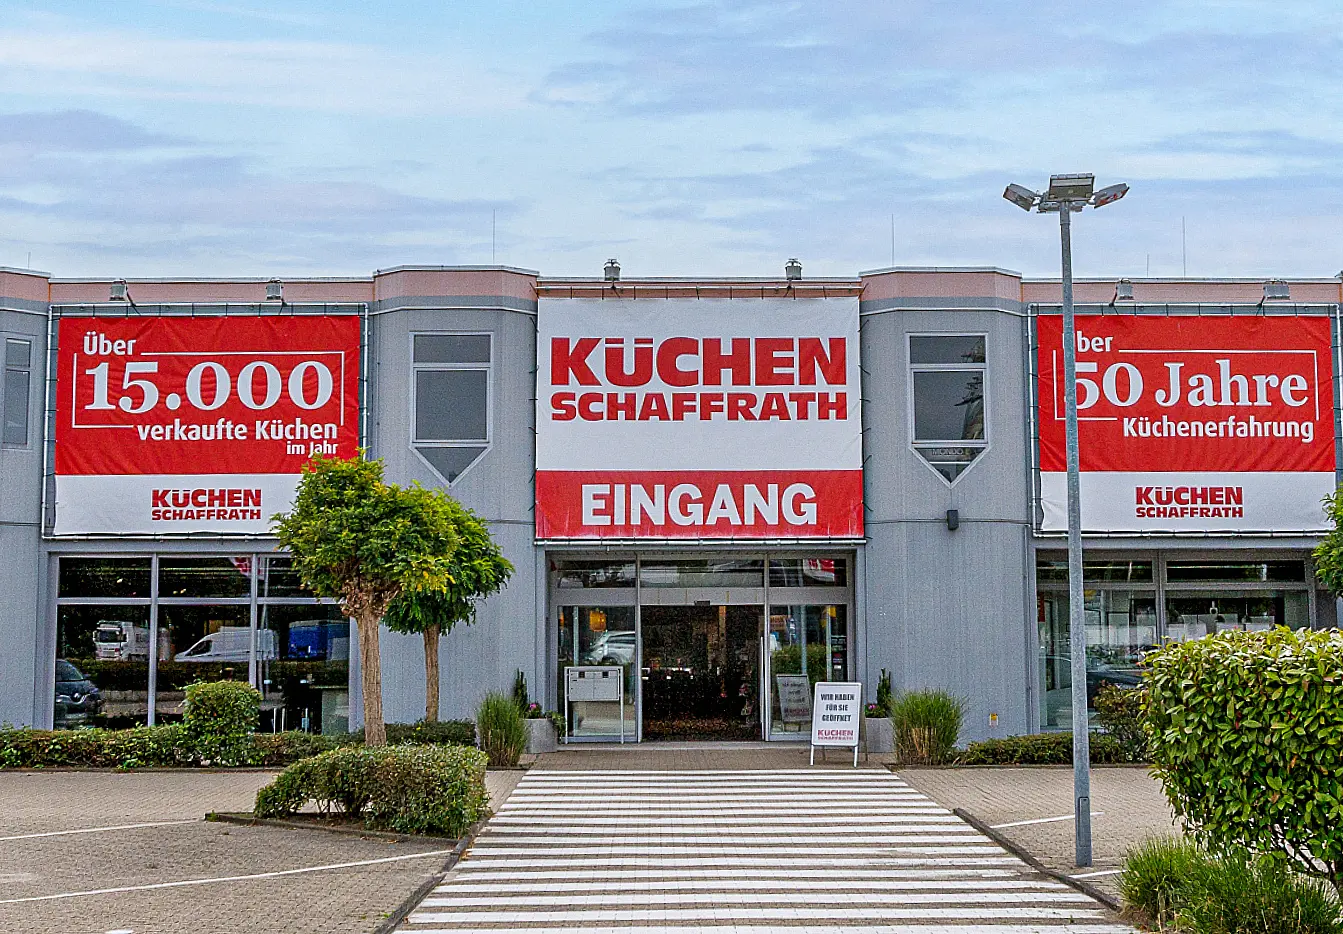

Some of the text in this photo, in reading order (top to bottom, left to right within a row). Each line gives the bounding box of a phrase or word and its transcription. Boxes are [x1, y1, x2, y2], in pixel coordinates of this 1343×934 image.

[82, 331, 137, 356] Über
[1062, 330, 1114, 353] ber
[550, 336, 847, 387] KÜCHEN
[84, 360, 334, 414] 15.000
[1064, 359, 1309, 410] 50 Jahre
[550, 391, 848, 421] SCHAFFRATH
[136, 417, 338, 441] verkaufte Küchen
[1123, 415, 1315, 443] Küchenerfahrung
[286, 440, 338, 458] im Jahr
[151, 488, 262, 508] KÜCHEN
[581, 483, 817, 526] EINGANG
[1135, 486, 1243, 506] KÜCHEN
[151, 508, 262, 521] SCHAFFRATH
[1135, 506, 1244, 518] SCHAFFRATH
